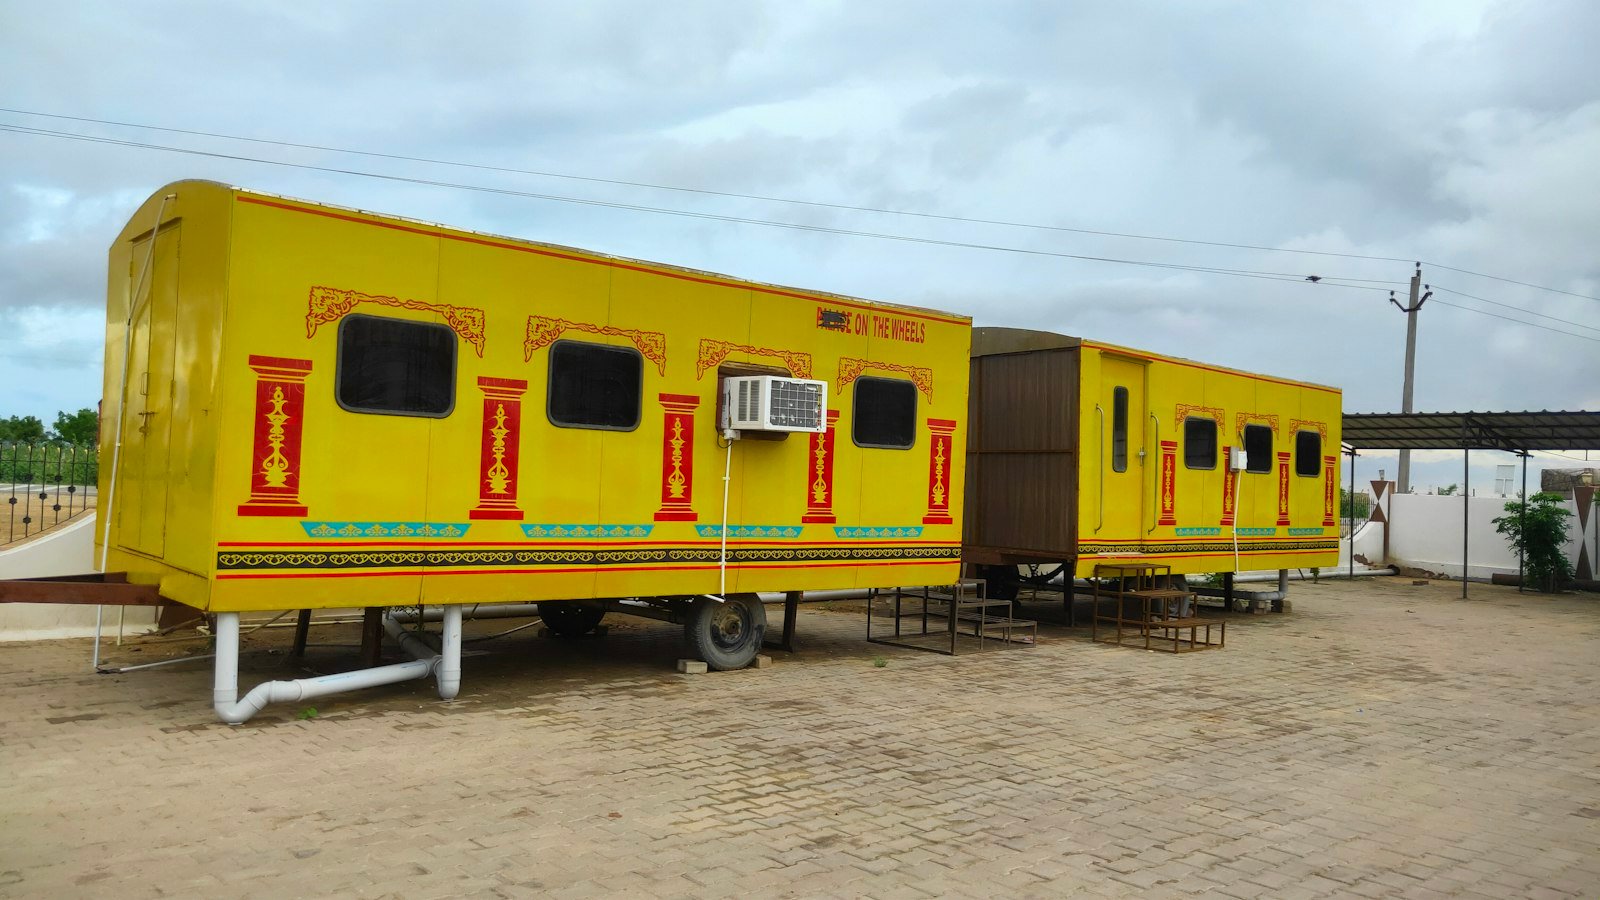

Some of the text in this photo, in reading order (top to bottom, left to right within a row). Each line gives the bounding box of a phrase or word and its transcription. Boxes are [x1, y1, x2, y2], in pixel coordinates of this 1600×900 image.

[855, 313, 868, 336] ON
[873, 315, 889, 339] THE
[891, 318, 925, 344] WHEELS
